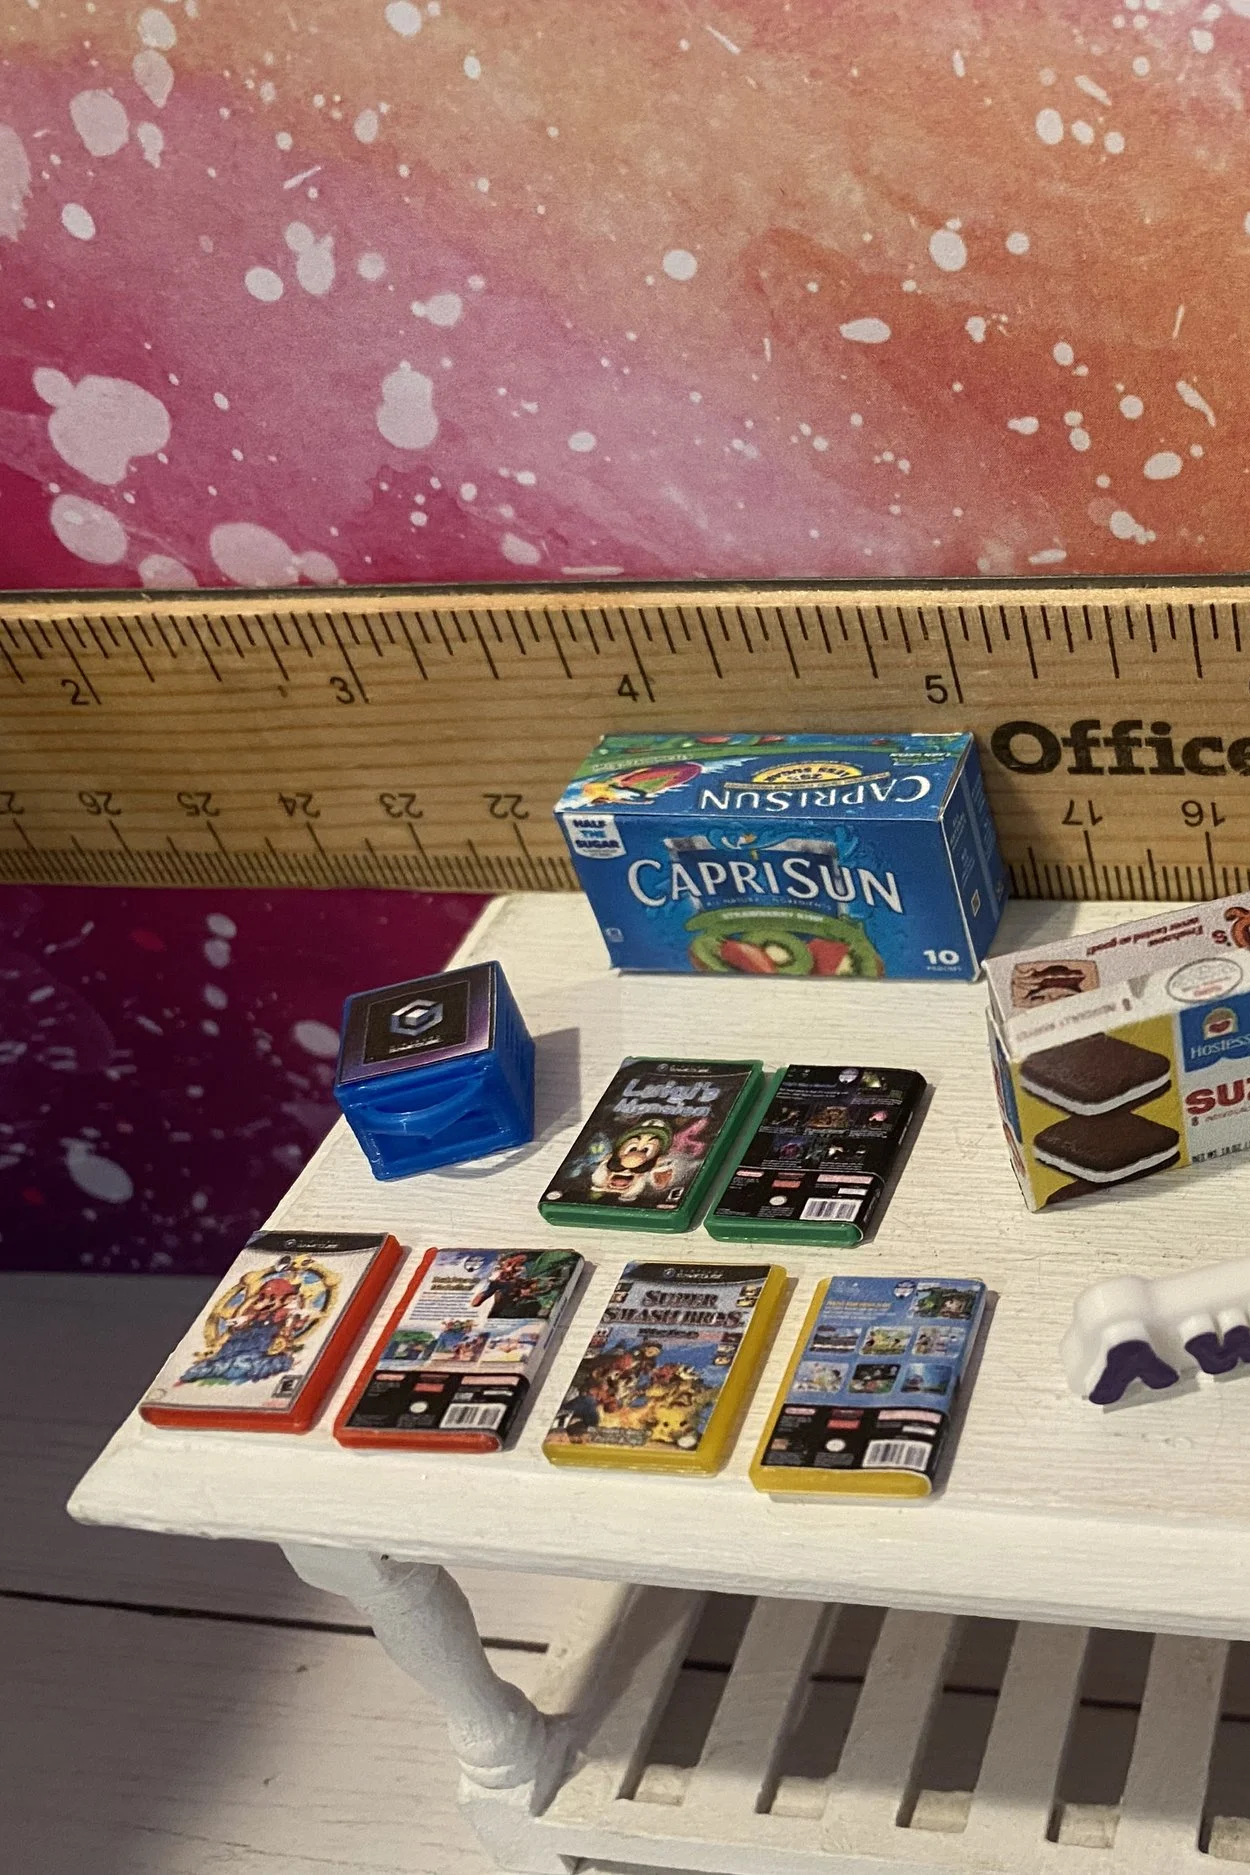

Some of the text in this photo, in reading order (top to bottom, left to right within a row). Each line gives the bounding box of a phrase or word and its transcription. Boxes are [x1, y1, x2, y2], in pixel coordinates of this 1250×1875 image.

[61, 679, 90, 706] 2
[329, 676, 355, 704] 3
[617, 674, 639, 703] 4
[925, 675, 948, 704] 5
[573, 818, 608, 830] HALF
[575, 838, 621, 849] SUGAR
[923, 950, 960, 966] 10
